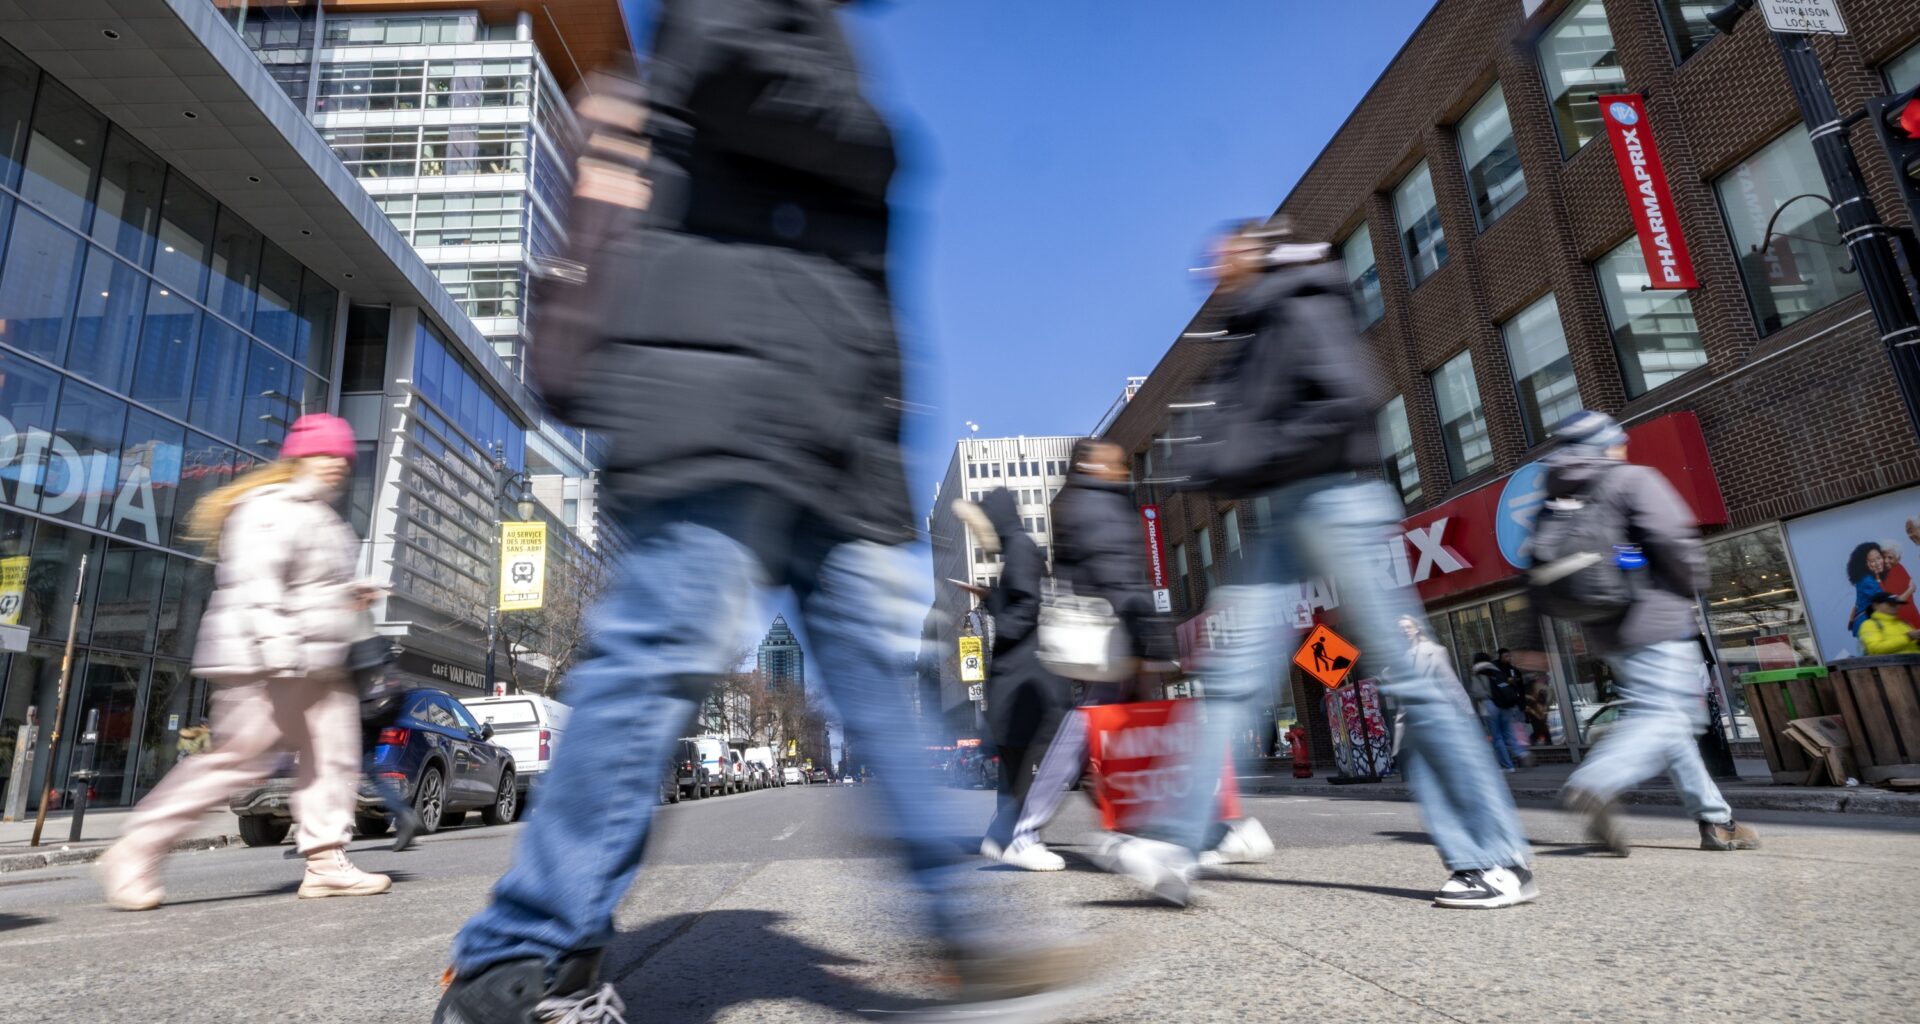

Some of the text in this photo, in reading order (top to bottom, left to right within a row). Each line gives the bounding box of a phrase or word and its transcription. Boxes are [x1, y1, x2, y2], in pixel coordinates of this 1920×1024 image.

[1772, 6, 1830, 17] LIVRAISON
[1784, 18, 1827, 29] LOCALE
[1621, 128, 1682, 283] PHARMAPRIX
[1147, 520, 1163, 587] PHARMAPRIX
[1157, 591, 1164, 600] P
[432, 664, 486, 689] CAFÉ VAN HOUTT
[970, 686, 981, 696] 30
